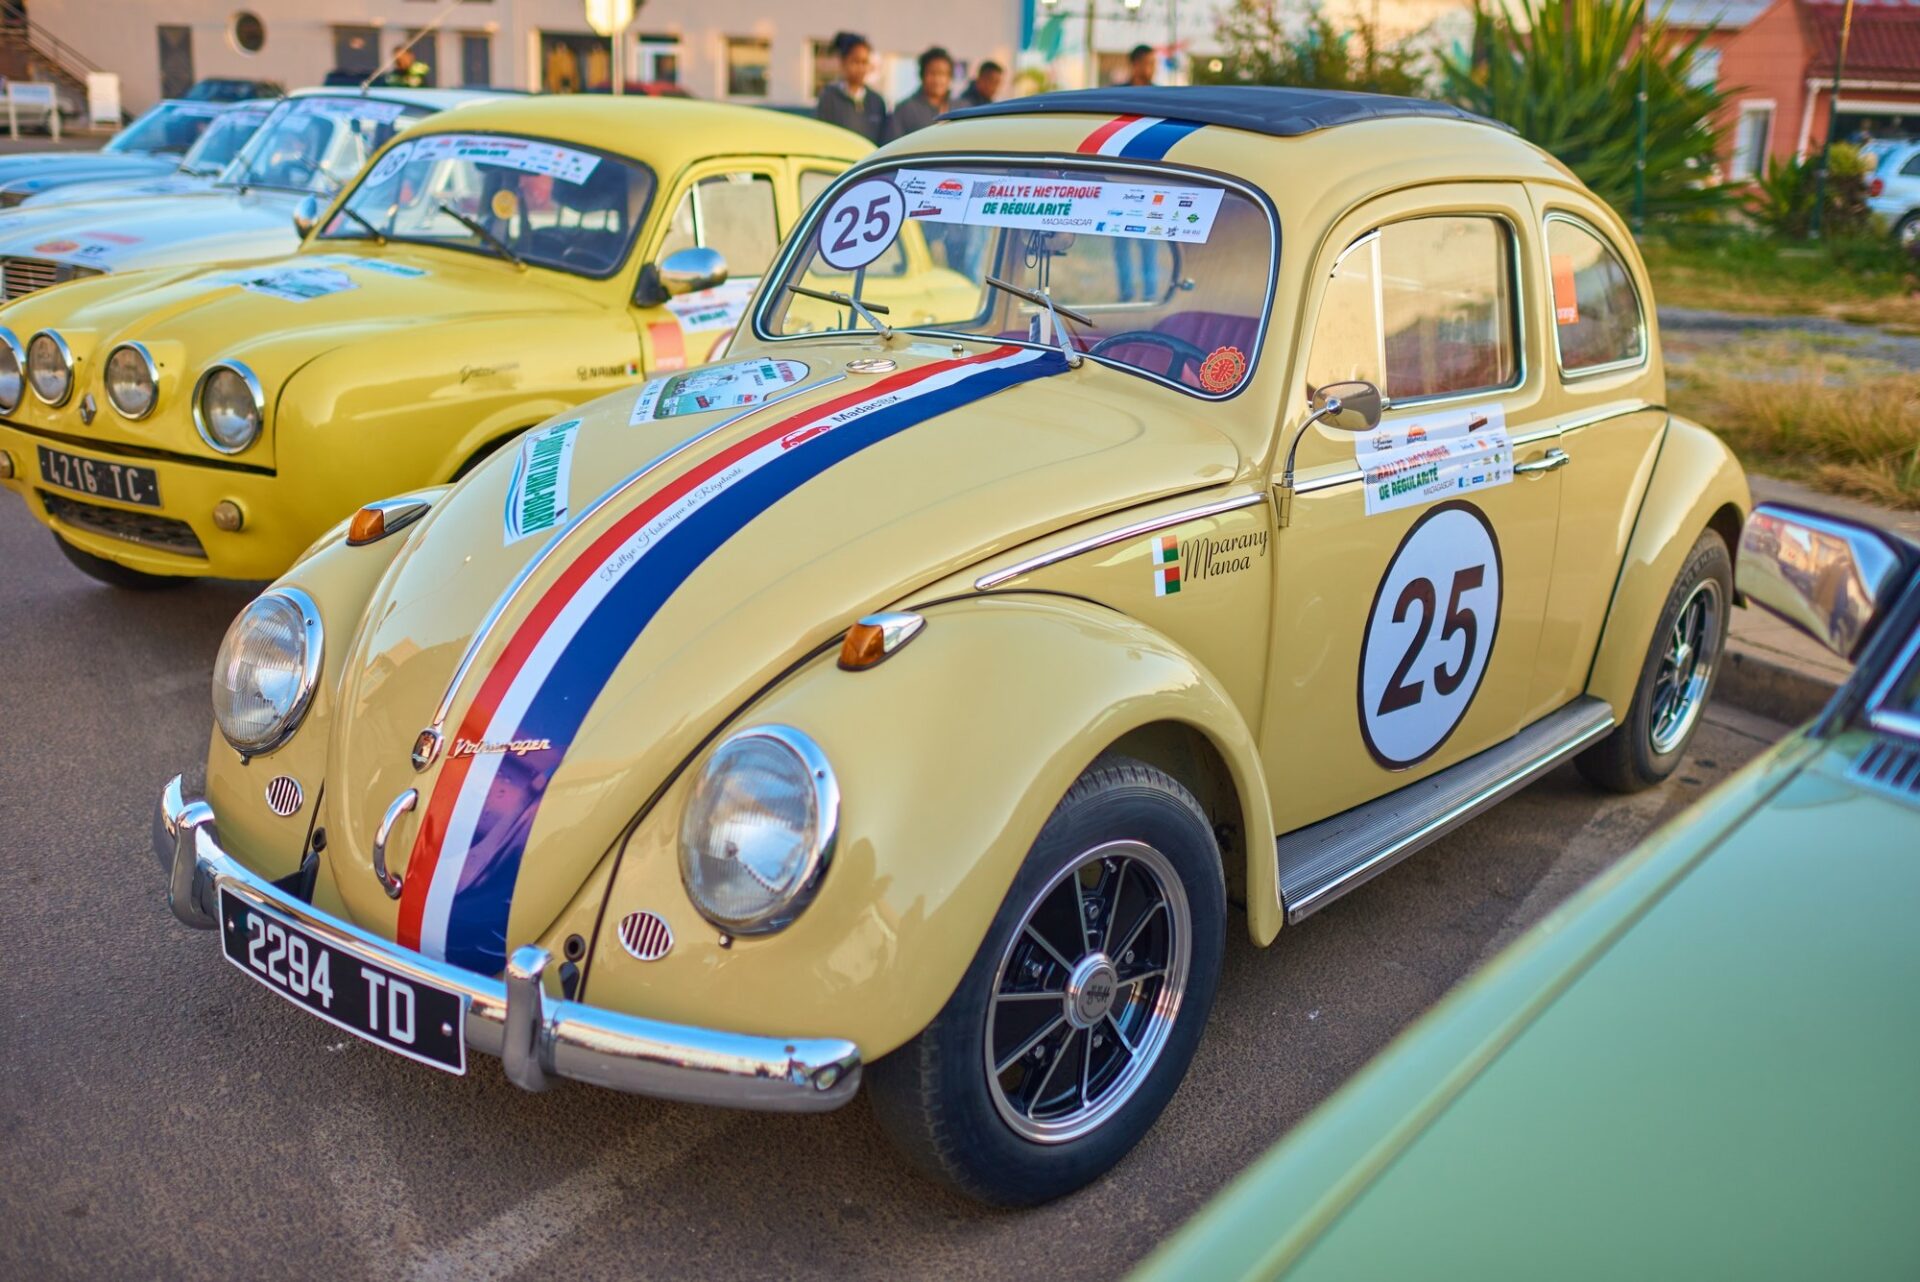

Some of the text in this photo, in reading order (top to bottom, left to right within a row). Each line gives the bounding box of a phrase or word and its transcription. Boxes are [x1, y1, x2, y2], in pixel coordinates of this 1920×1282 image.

[982, 198, 1072, 215] DE RÉGULARITÉ
[988, 184, 1102, 199] RALLYE HISTORIQUE
[831, 194, 891, 253] 25
[1041, 217, 1092, 226] MADAGASCAR
[49, 451, 142, 501] 4216 TC
[1379, 484, 1390, 500] DE
[600, 548, 637, 582] Rallye
[1181, 531, 1267, 582] Mparany
[1376, 563, 1485, 717] 25
[446, 738, 551, 759] Volkswagen
[246, 912, 416, 1045] 2294 TD
